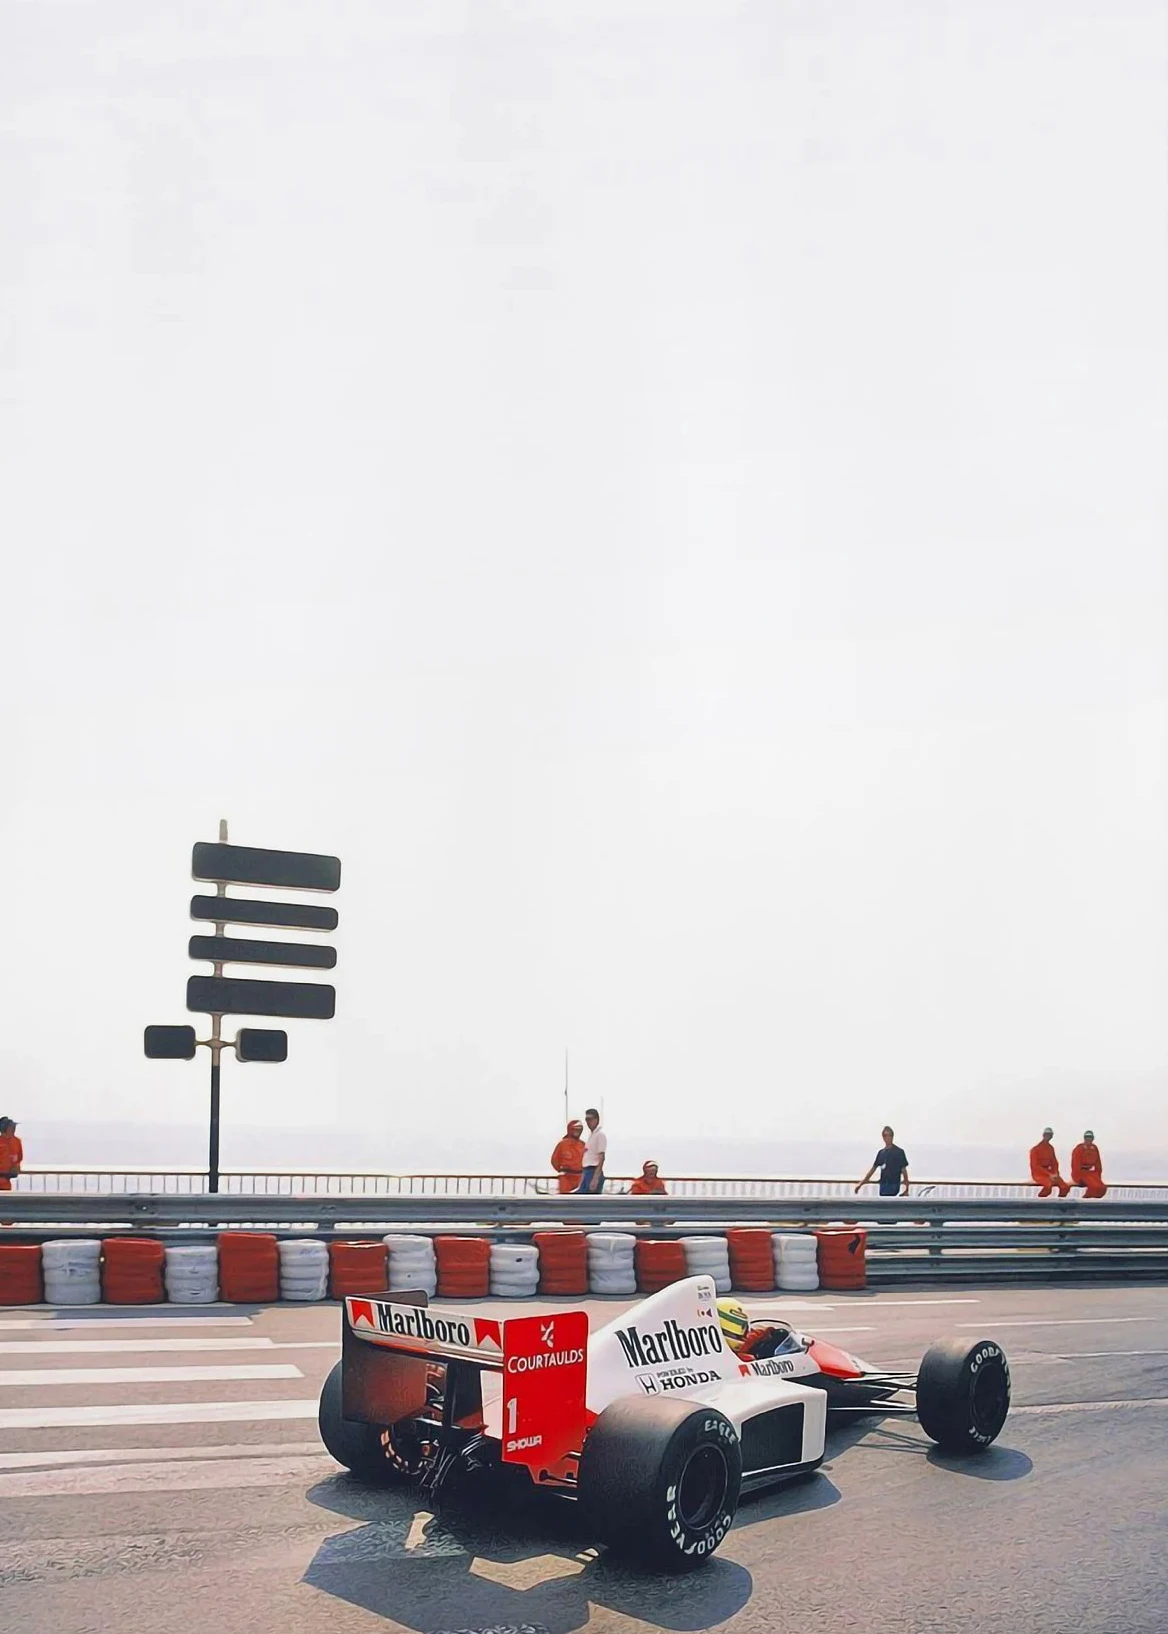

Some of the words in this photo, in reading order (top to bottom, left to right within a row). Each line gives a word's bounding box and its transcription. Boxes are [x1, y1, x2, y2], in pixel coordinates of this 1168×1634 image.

[376, 1303, 470, 1346] Marlboro
[615, 1320, 722, 1368] Marlboro
[508, 1348, 584, 1374] COURTAULDS
[751, 1360, 794, 1376] Marlboro
[660, 1370, 722, 1390] HONDA
[507, 1398, 518, 1434] 1
